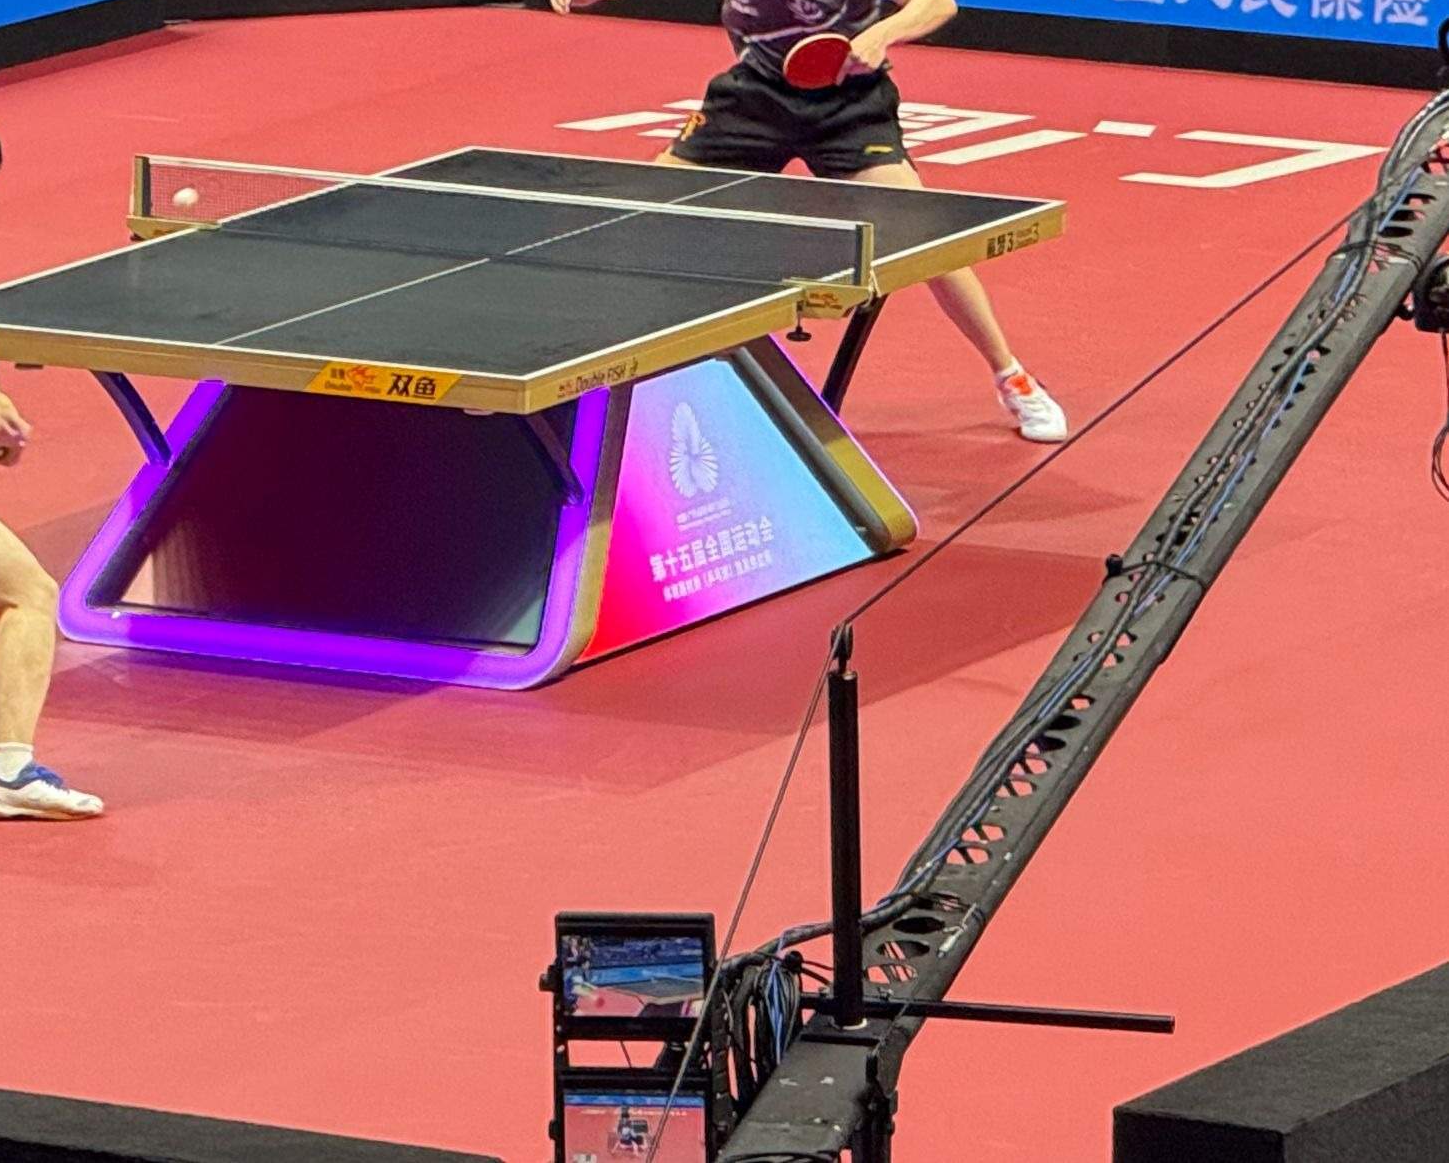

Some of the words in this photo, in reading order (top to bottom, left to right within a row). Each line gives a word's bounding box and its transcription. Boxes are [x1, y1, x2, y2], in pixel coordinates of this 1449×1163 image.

[386, 371, 438, 401] 双鱼
[649, 515, 775, 582] 第十五届全国运动会
